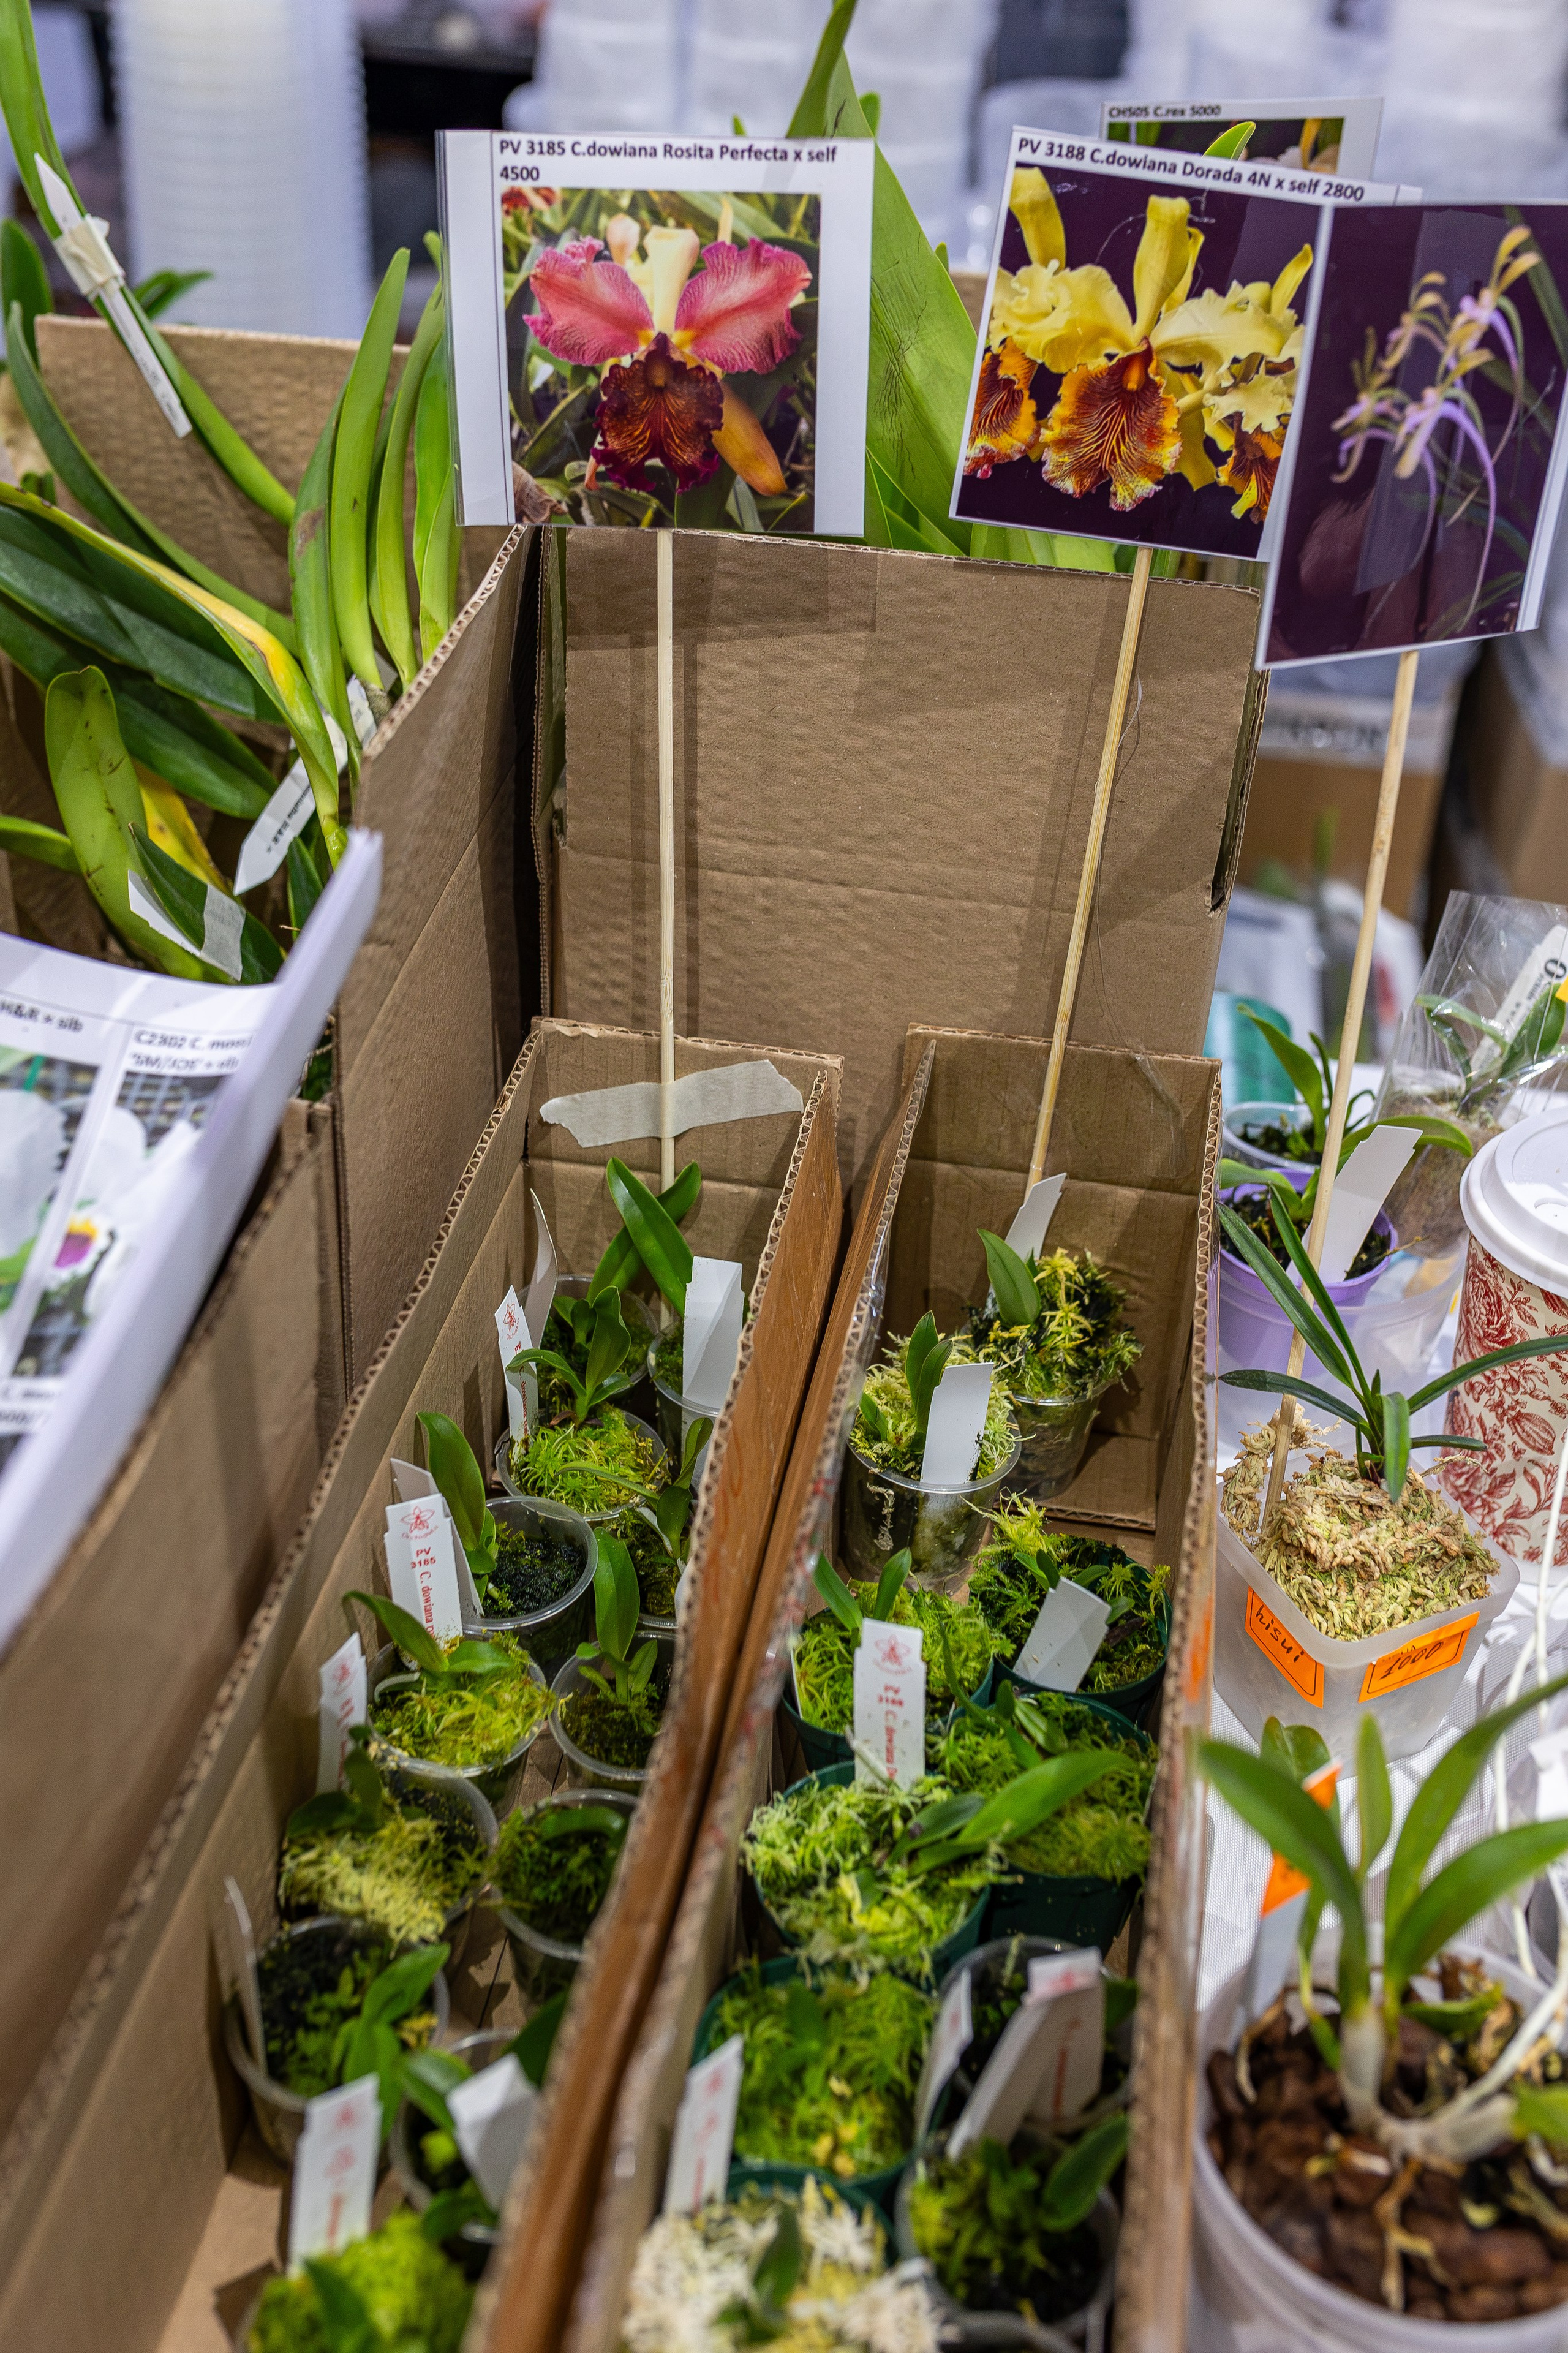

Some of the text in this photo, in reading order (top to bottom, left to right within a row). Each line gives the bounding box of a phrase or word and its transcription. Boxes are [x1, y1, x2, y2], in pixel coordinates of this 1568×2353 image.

[1190, 104, 1221, 116] 5000
[500, 140, 838, 162] PV 3185 C.dowiana Rosita Perfecta x self
[500, 166, 540, 181] 4500
[1019, 138, 1365, 202] PV 3188 C.dowiana Dorada 4N x self 2800
[416, 1547, 431, 1557] PV
